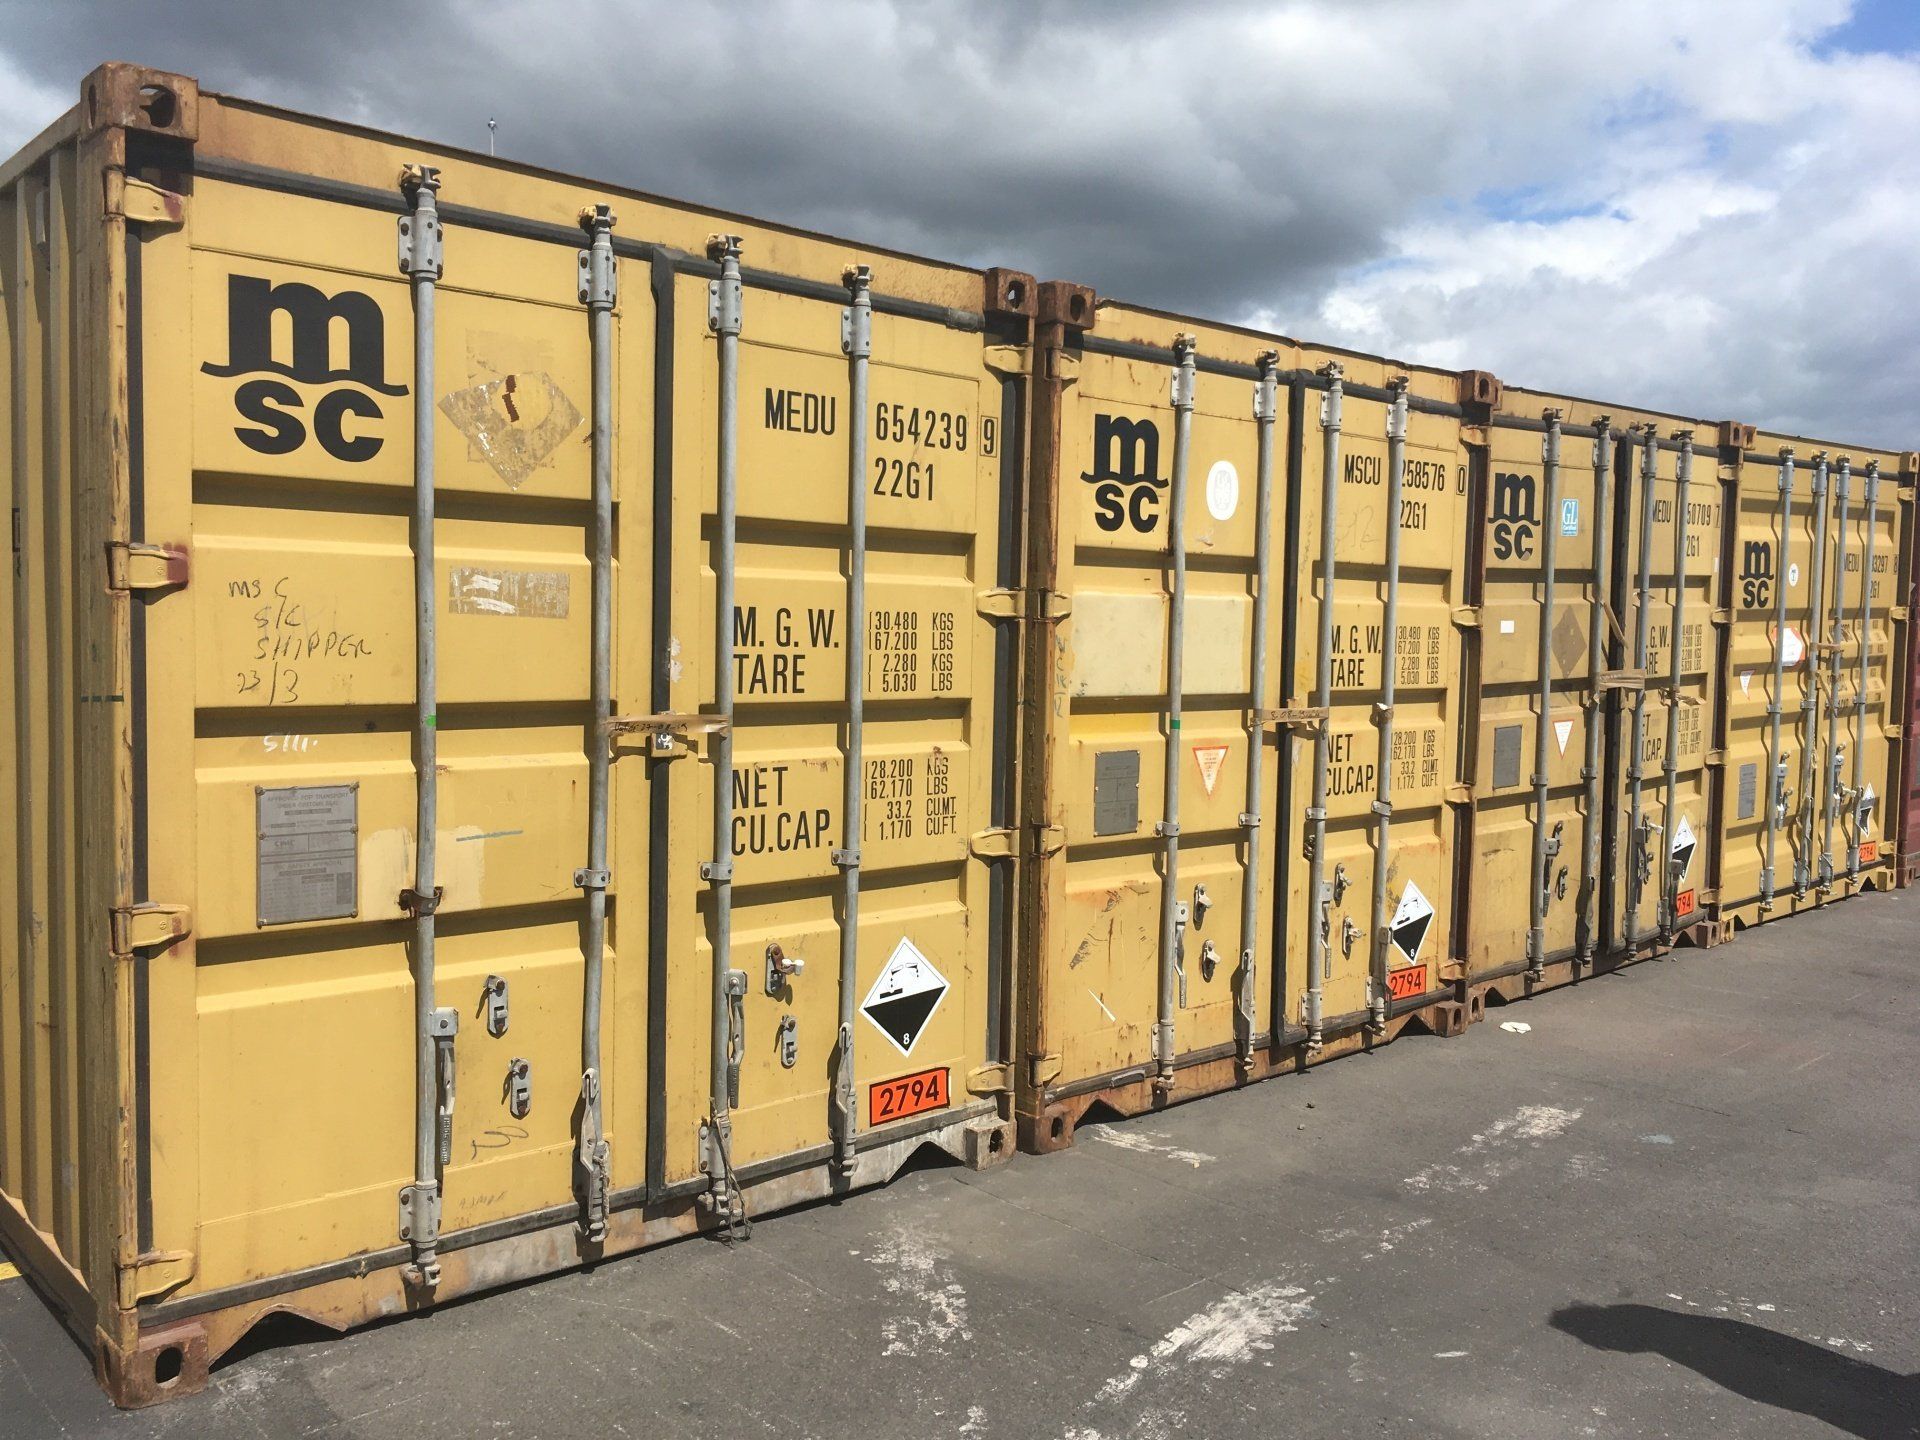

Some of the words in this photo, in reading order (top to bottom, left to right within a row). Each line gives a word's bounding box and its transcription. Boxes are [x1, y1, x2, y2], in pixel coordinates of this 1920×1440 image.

[765, 387, 836, 436] MEDU
[876, 402, 968, 452] 654239
[983, 418, 995, 455] 9
[873, 457, 934, 501] 22G1
[1344, 454, 1381, 485] MSCU
[1563, 501, 1577, 525] GL
[1686, 503, 1711, 526] 50709
[1686, 535, 1700, 557] 2G1
[733, 606, 765, 648] M.
[776, 607, 799, 648] G.
[808, 608, 840, 649] W.
[875, 611, 918, 631] 30,480
[932, 612, 954, 632] KGS
[1350, 625, 1361, 653] G.
[1428, 627, 1440, 641] KGS
[874, 631, 918, 652] 67,200
[932, 632, 954, 651] LBS
[1427, 641, 1439, 655] LBS
[733, 654, 806, 694] TARE
[882, 653, 917, 673] 2,280
[931, 653, 953, 672] KGS
[1427, 656, 1439, 671] KGS
[1645, 652, 1659, 675] ARE
[882, 672, 917, 693] 5,030
[931, 672, 953, 692] LBS
[1426, 671, 1439, 685] LBS
[1423, 730, 1436, 744] KGS
[1422, 744, 1435, 758] LBS
[1642, 738, 1662, 763] .CAP.
[732, 766, 789, 810] NET
[871, 758, 913, 780] 28,200
[926, 757, 949, 777] KGS
[870, 778, 913, 800] 62,170
[926, 776, 948, 796] LBS
[732, 808, 834, 857] CU.CAP.
[886, 800, 912, 820] 33.2
[926, 797, 957, 817] CU.MT.
[879, 819, 912, 841] 1,170
[926, 816, 957, 837] CU.FT.
[1677, 893, 1691, 912] 794
[1390, 970, 1422, 996] 2794
[903, 1033, 909, 1044] 8
[880, 1074, 940, 1117] 2794
